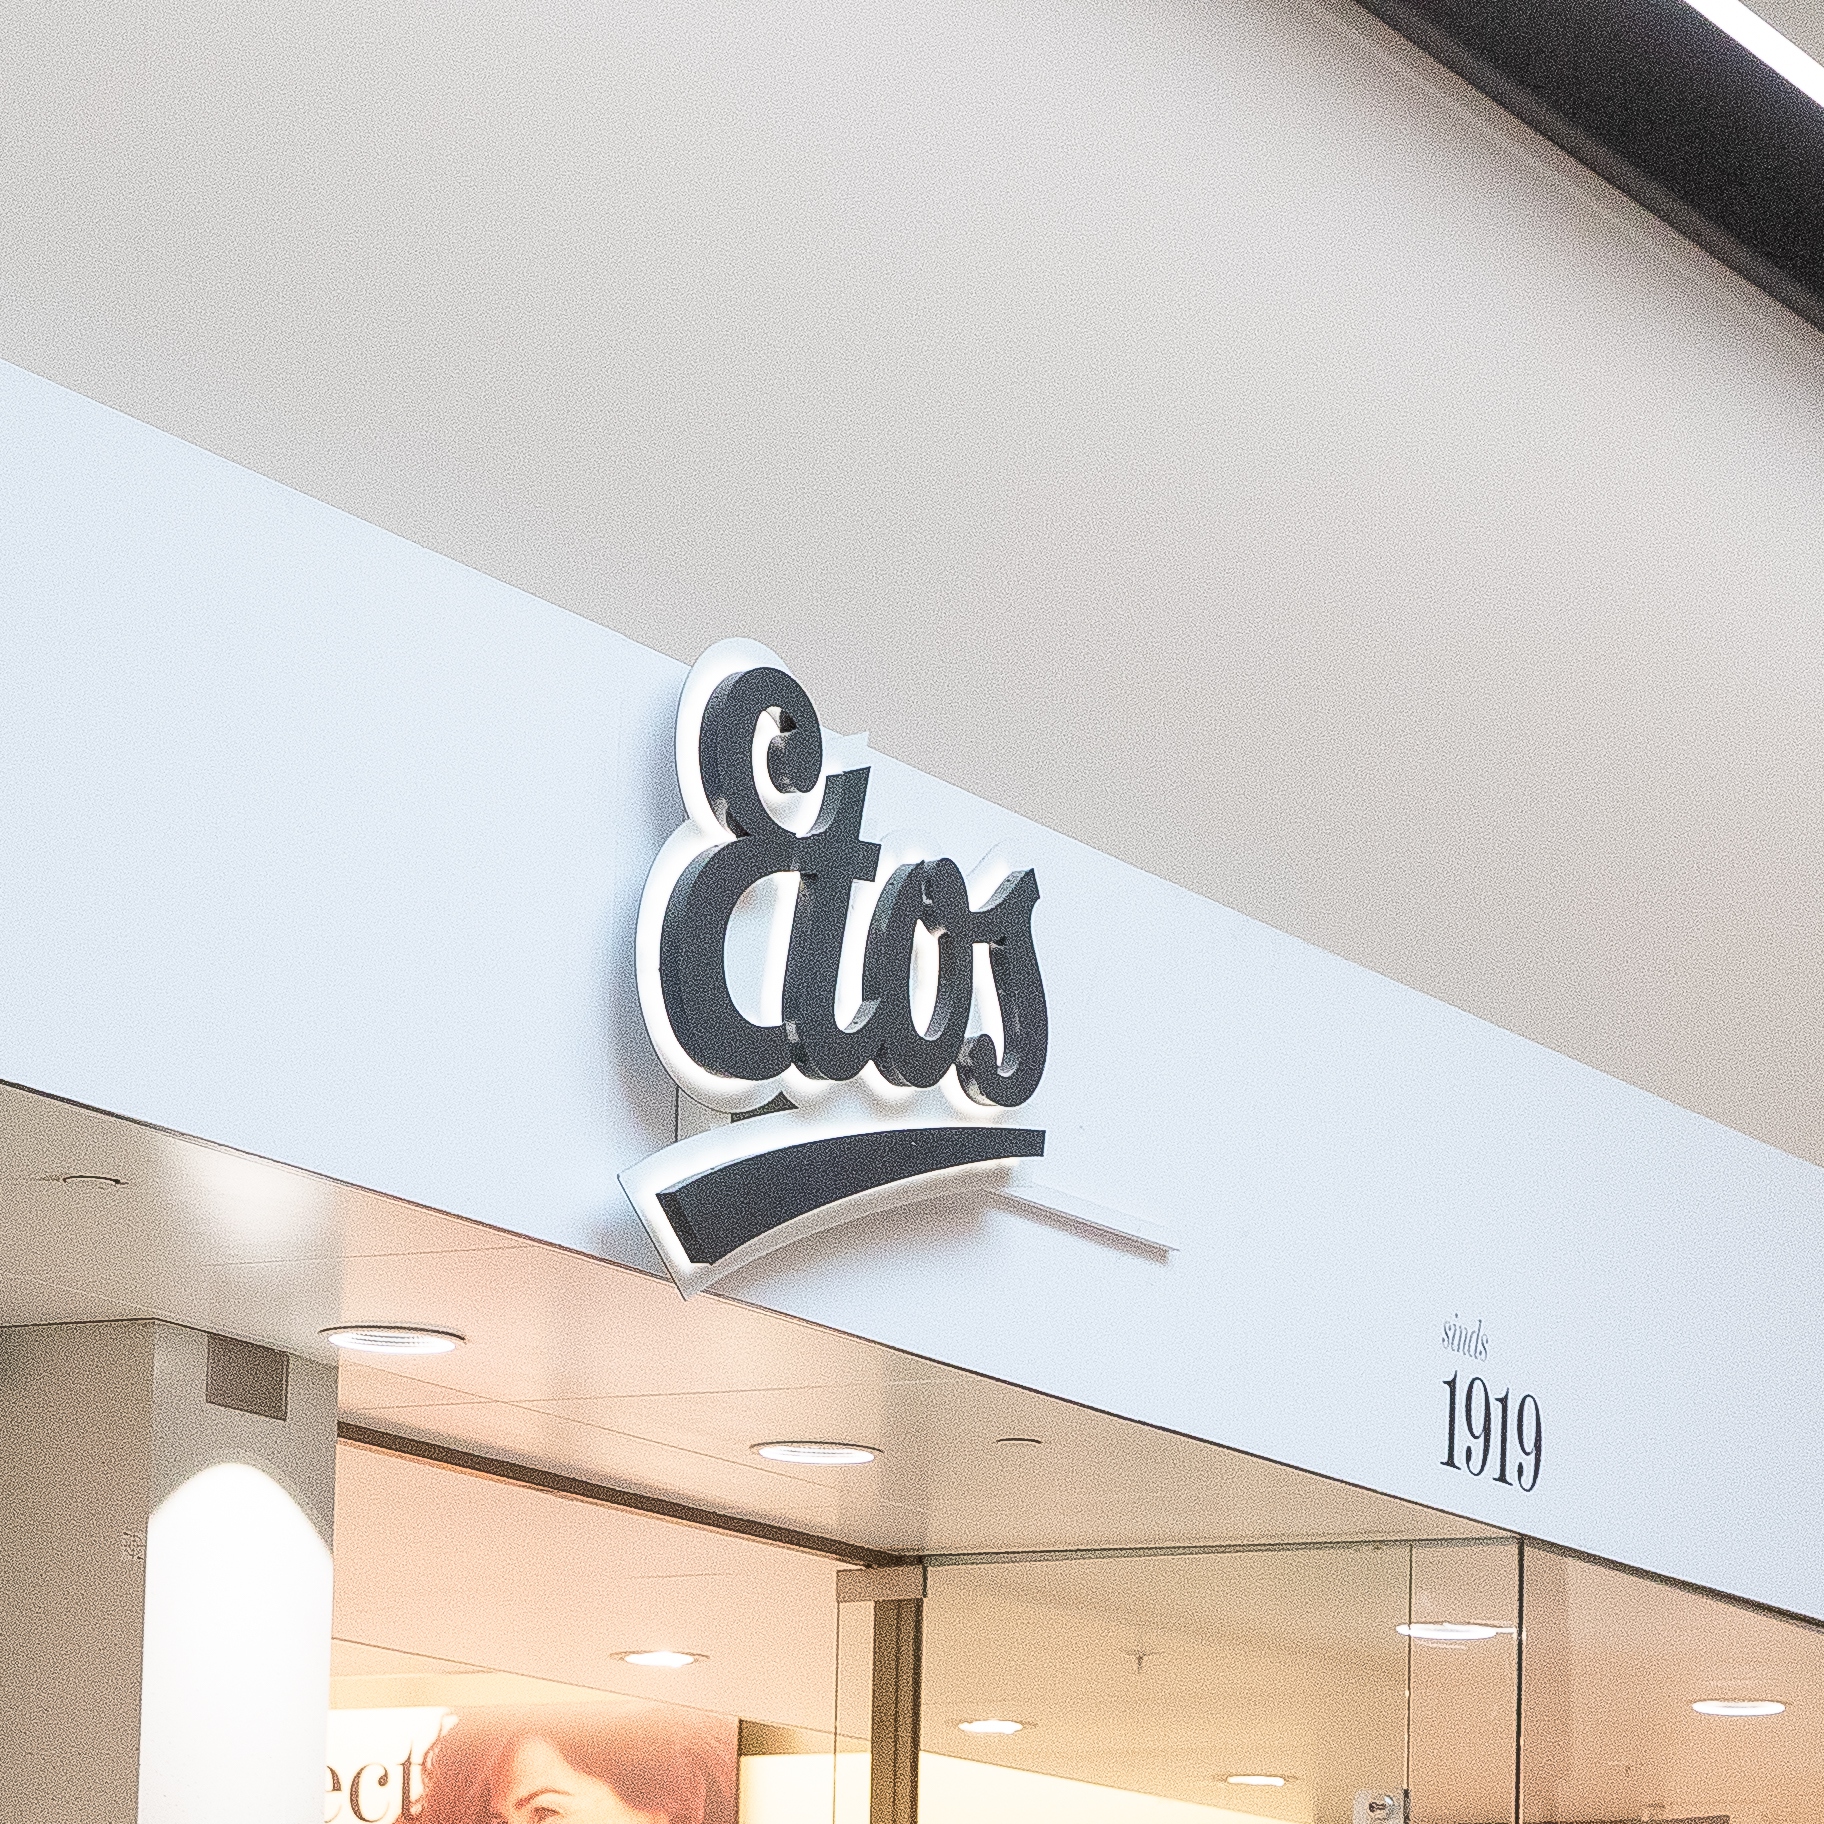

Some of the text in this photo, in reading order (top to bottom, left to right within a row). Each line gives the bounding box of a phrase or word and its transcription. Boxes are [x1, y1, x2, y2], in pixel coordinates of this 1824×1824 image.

[656, 664, 1049, 1109] Etos
[1440, 1311, 1490, 1363] sinds
[1439, 1369, 1544, 1492] 1919
